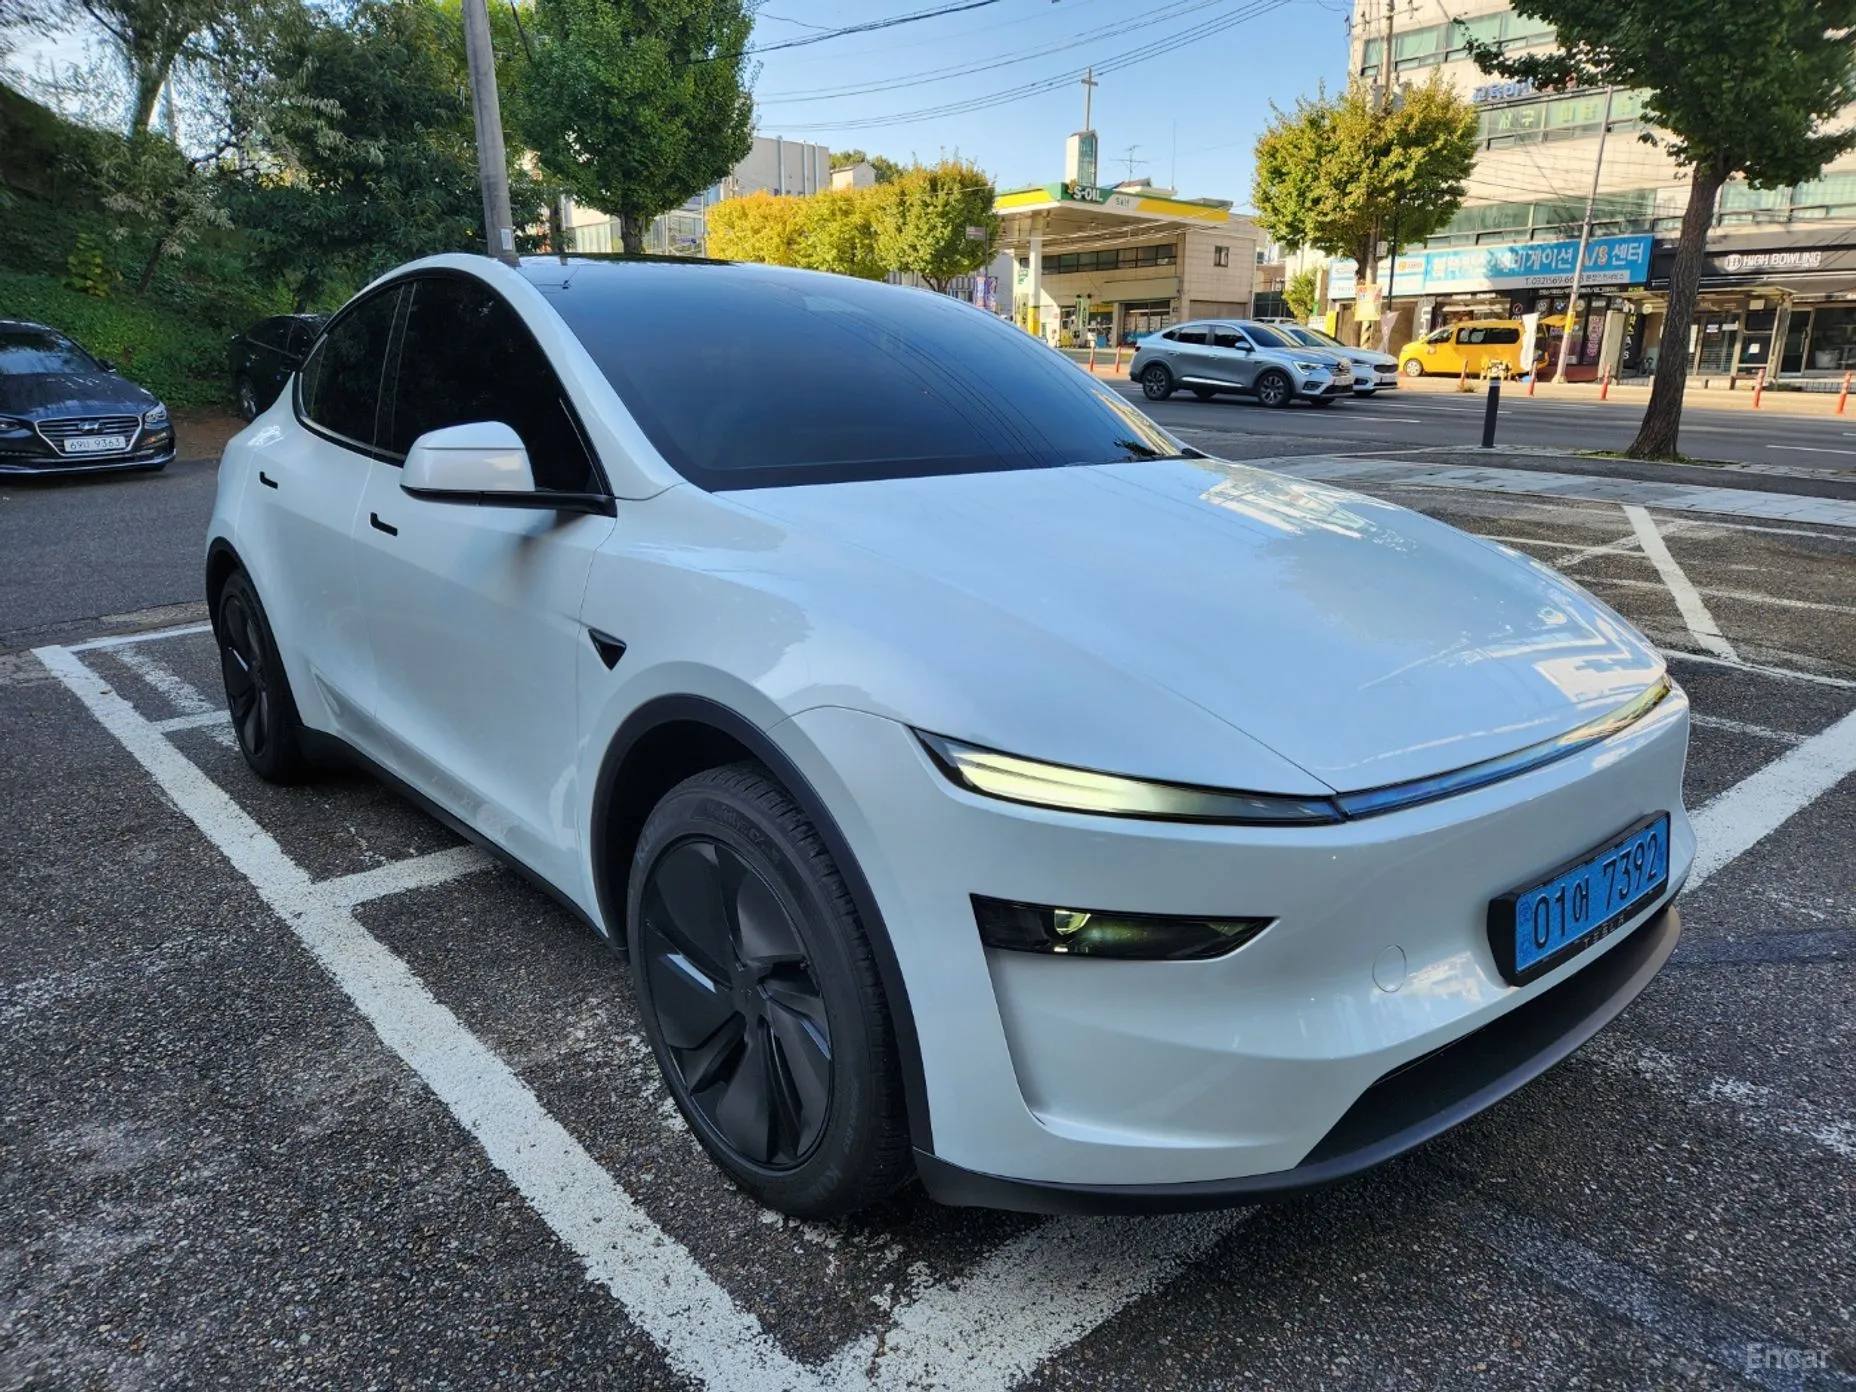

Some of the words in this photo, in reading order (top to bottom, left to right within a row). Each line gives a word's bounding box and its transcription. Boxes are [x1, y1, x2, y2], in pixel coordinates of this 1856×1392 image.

[1073, 186, 1104, 201] S-OIL
[1611, 242, 1644, 266] 센터
[1743, 254, 1770, 266] HIGH
[1771, 252, 1821, 265] BOWLING
[94, 438, 120, 448] 9363
[1533, 876, 1590, 948] 01어
[1602, 832, 1659, 911] 7392
